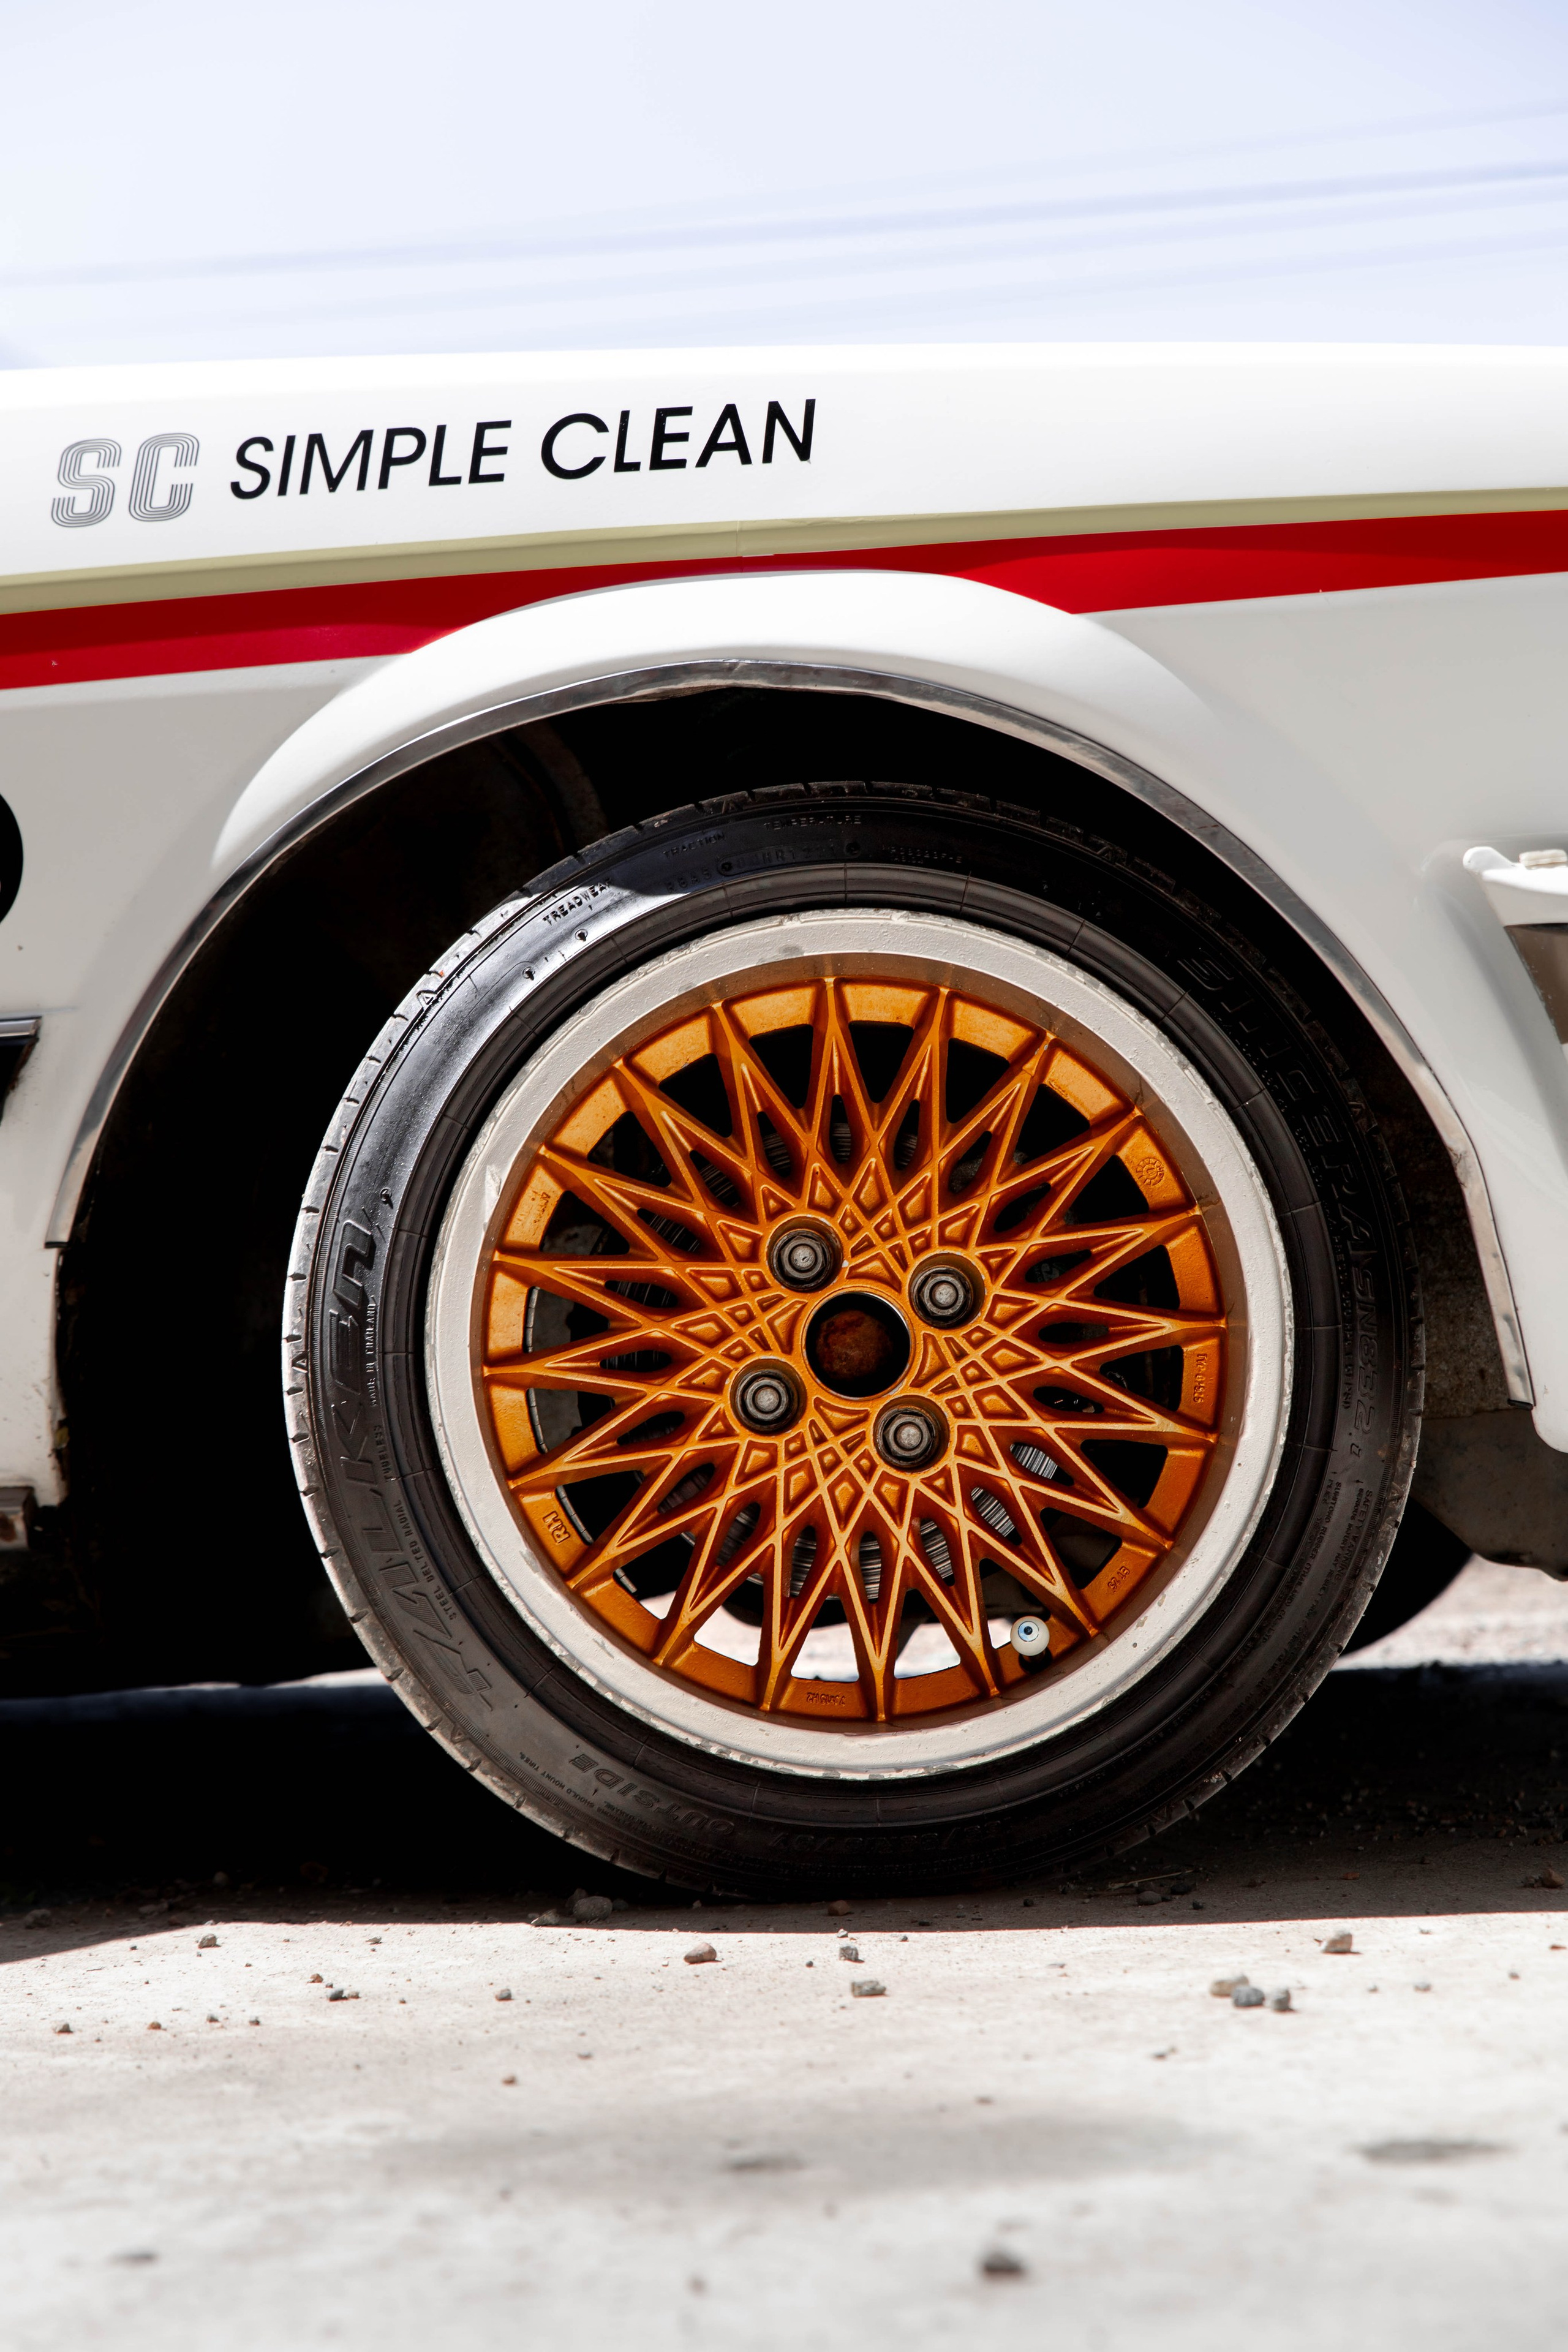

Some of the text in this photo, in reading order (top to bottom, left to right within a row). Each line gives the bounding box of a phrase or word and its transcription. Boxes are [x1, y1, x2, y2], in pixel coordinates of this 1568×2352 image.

[231, 399, 815, 499] SIMPLE CLEAN
[763, 815, 861, 831] TEMPERATURE
[662, 832, 726, 859] TRACTION
[541, 876, 614, 927] TREADWEAR
[364, 1302, 378, 1407] MADE IN THAILAND
[329, 1219, 492, 1711] FALKEN
[372, 1424, 458, 1621] STEEL BELTED RADIAL TUBELESS
[1323, 1480, 1344, 1524] SUMITOMO
[1354, 1489, 1374, 1531] SAFETY
[542, 1510, 570, 1544] RH
[1308, 1525, 1329, 1561] RUBBER
[540, 1769, 567, 1790] MOUNT
[568, 1754, 735, 1836] OUTSIDE
